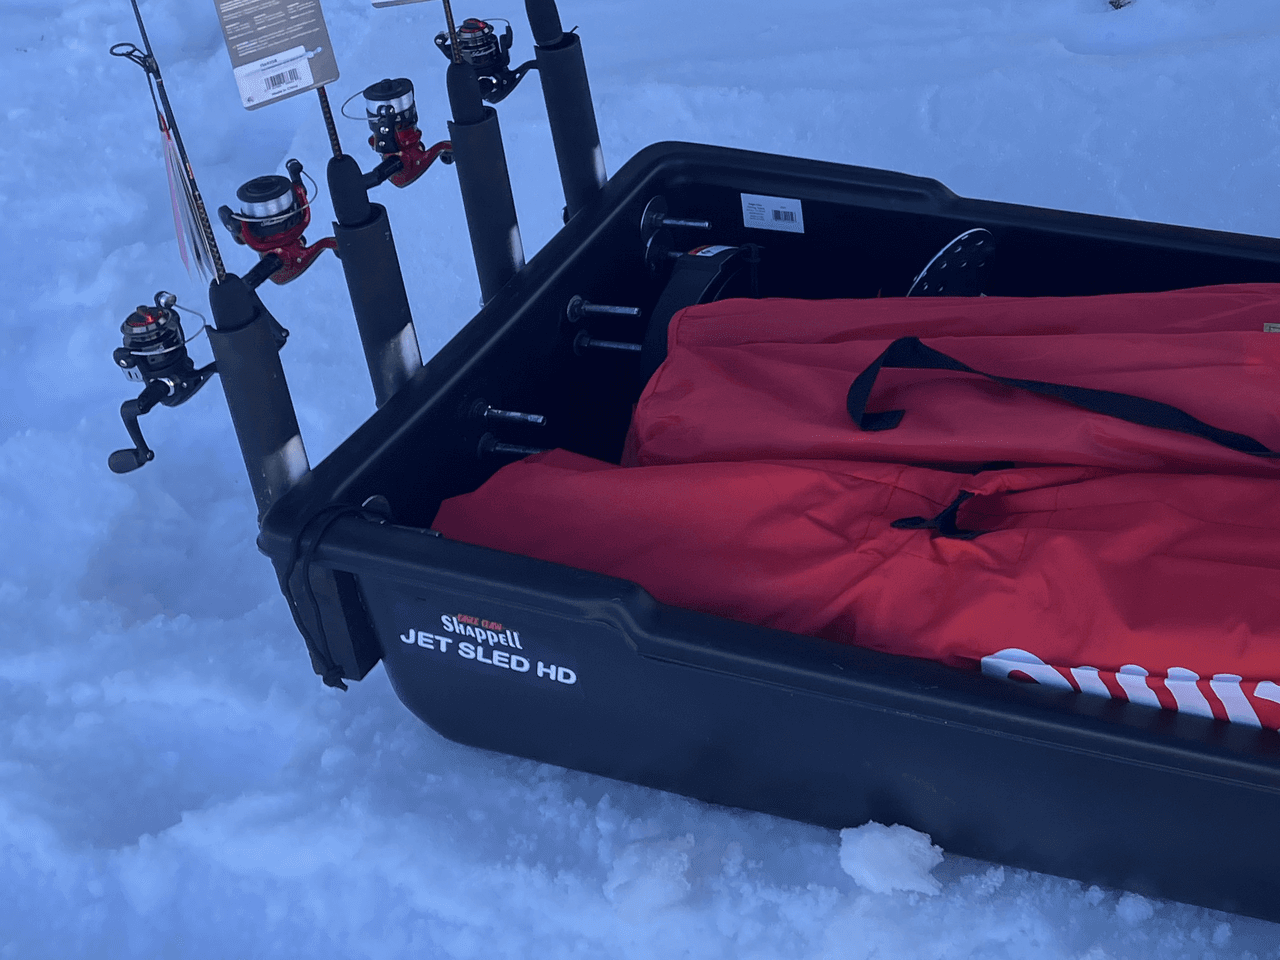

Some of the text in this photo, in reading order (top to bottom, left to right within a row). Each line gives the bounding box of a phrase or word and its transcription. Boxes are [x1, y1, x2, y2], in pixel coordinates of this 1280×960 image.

[400, 628, 577, 685] JET SLED HD
